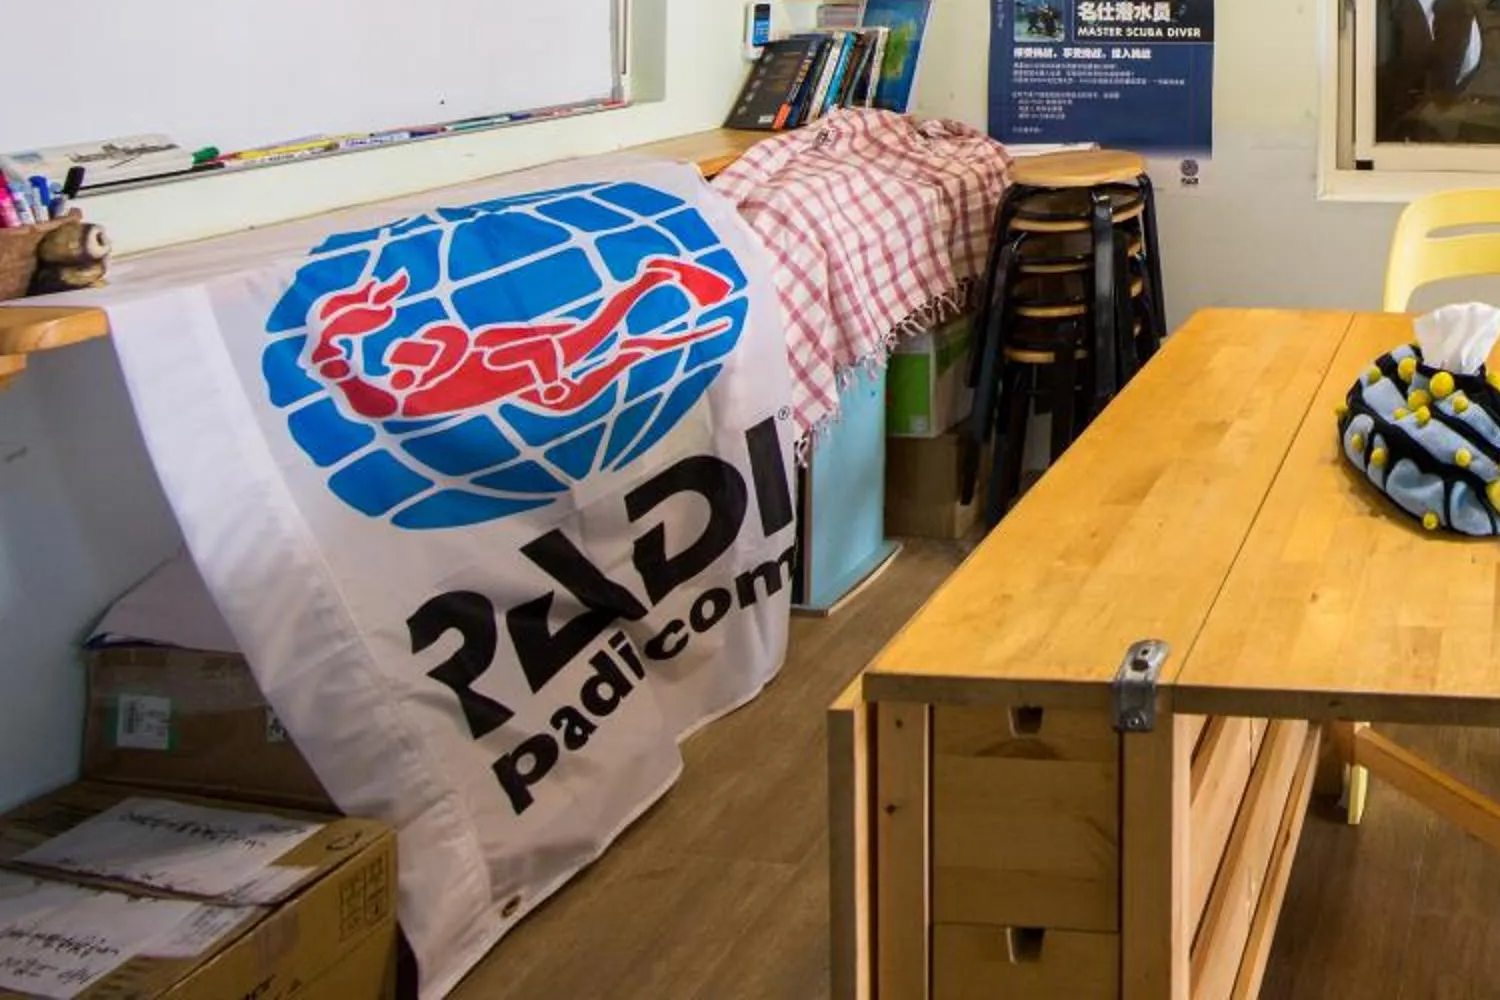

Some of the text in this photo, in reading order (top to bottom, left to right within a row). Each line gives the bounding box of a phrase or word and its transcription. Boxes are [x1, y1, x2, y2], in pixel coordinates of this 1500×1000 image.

[1077, 26, 1201, 38] MASTER SCUBA DIVER
[407, 416, 793, 740] PADI
[492, 545, 797, 815] padicom
